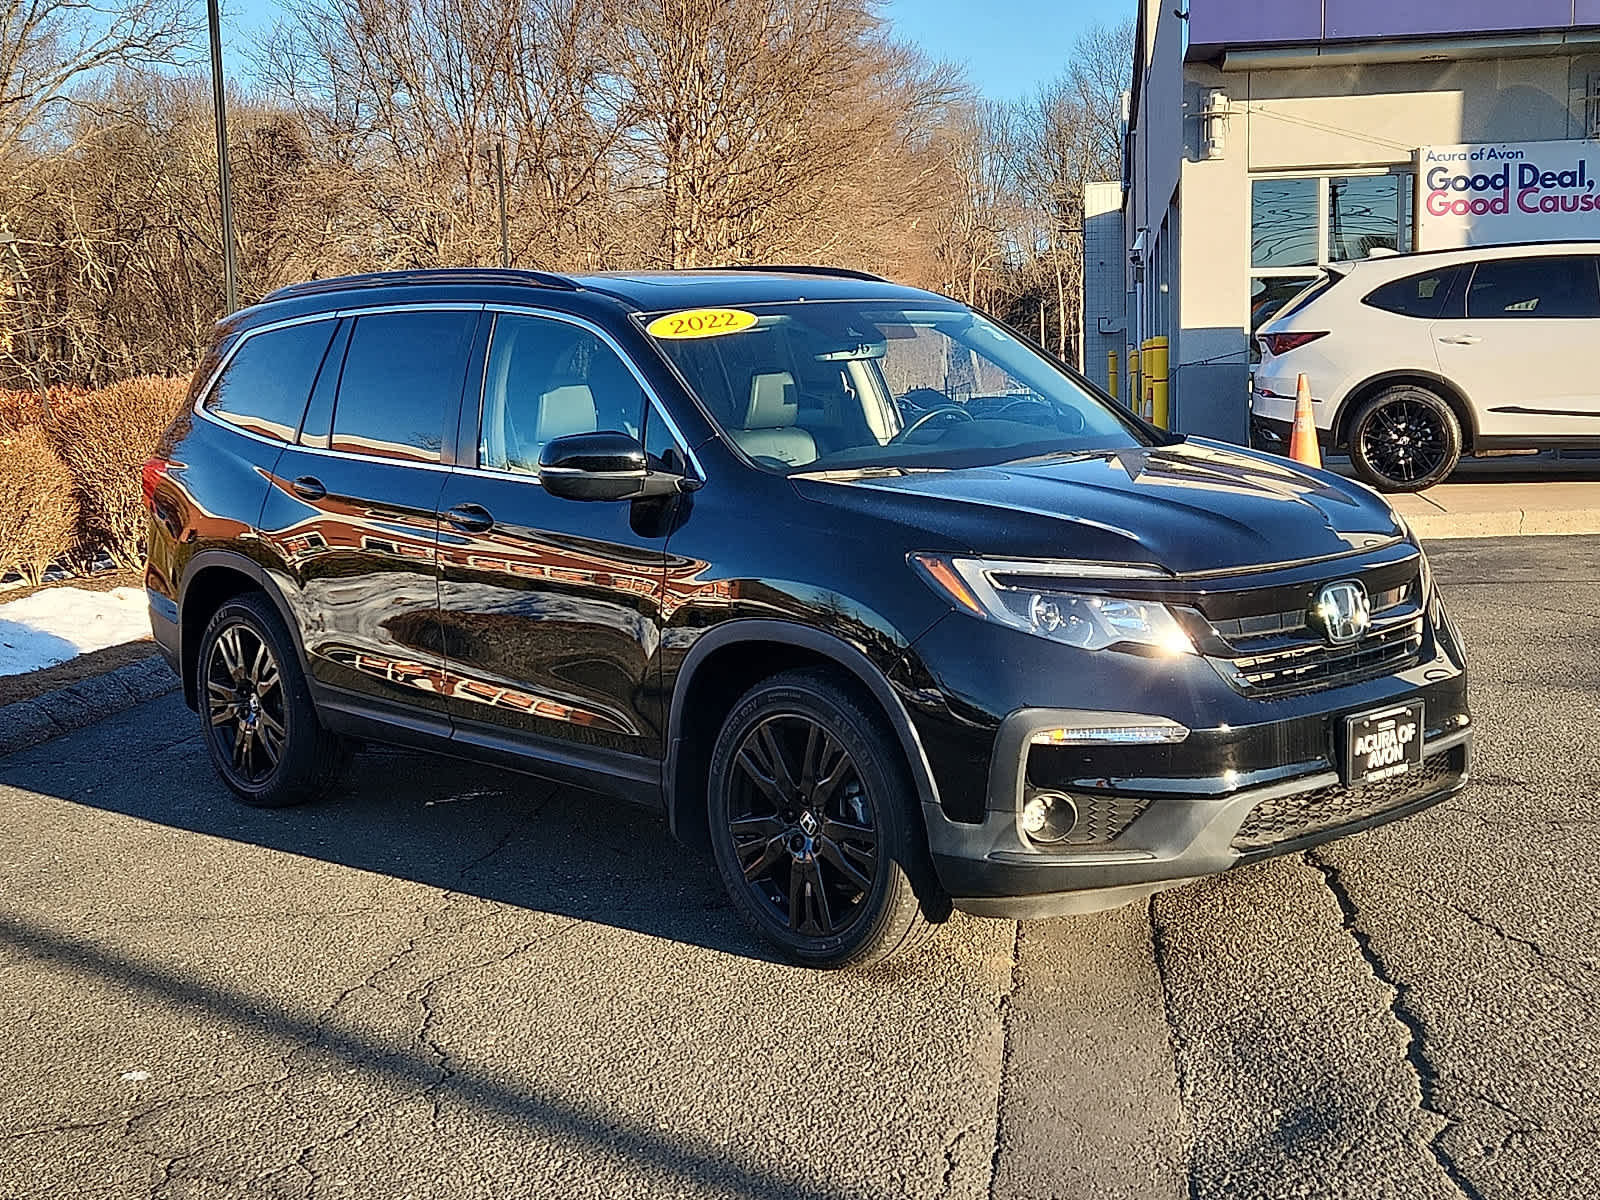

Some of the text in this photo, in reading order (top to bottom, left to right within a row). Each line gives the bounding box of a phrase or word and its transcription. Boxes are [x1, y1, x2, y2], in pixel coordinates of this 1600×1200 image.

[1425, 148, 1524, 162] Acura of Avon
[1426, 160, 1595, 192] Good Deal,
[1426, 187, 1600, 216] Good Caus
[669, 312, 738, 334] 2022
[1354, 729, 1398, 756] ACURA
[1398, 722, 1416, 744] OF
[1368, 743, 1404, 769] AVON
